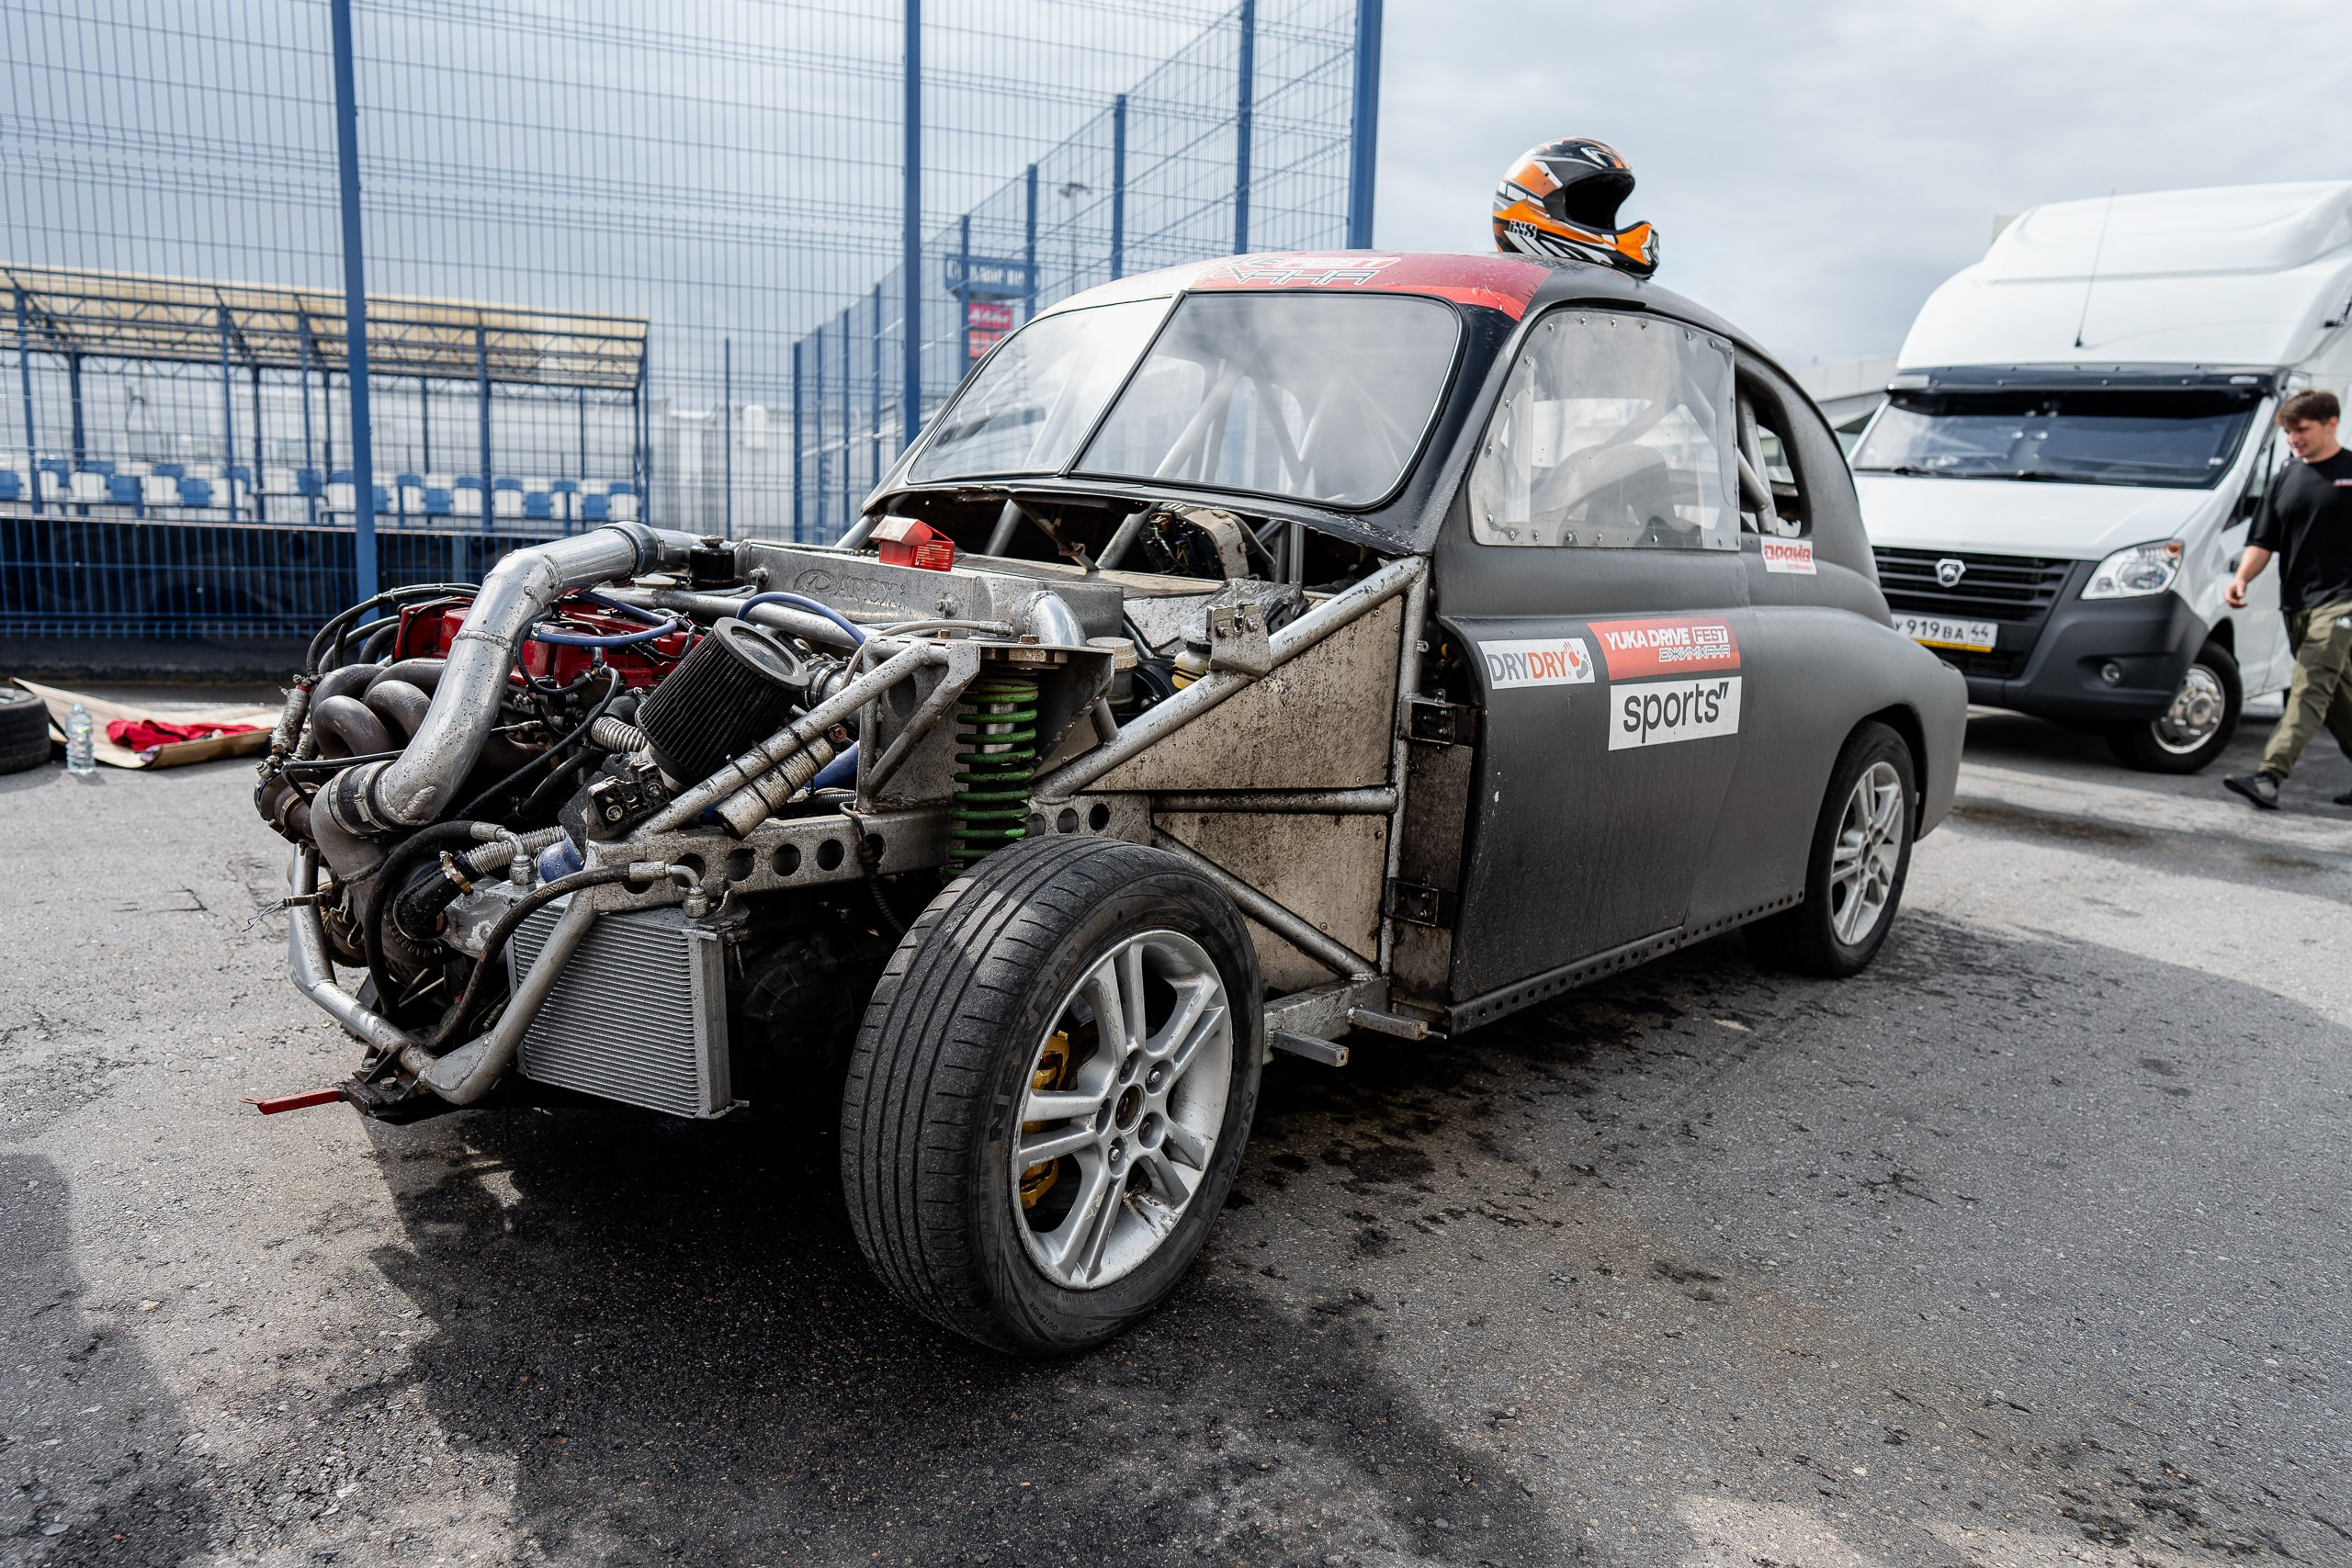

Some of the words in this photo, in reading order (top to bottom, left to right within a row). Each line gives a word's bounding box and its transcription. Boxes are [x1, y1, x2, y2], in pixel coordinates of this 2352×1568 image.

[1764, 544, 1811, 562] ДРАЙВ
[1604, 629, 1648, 651] YUKA
[1646, 627, 1690, 648] DRIVE
[1693, 627, 1726, 643] FEST
[1658, 644, 1731, 663] ДЖИМХАНА
[1486, 650, 1566, 682] DRYDRY
[1028, 1301, 1059, 1332] OUTSIDE
